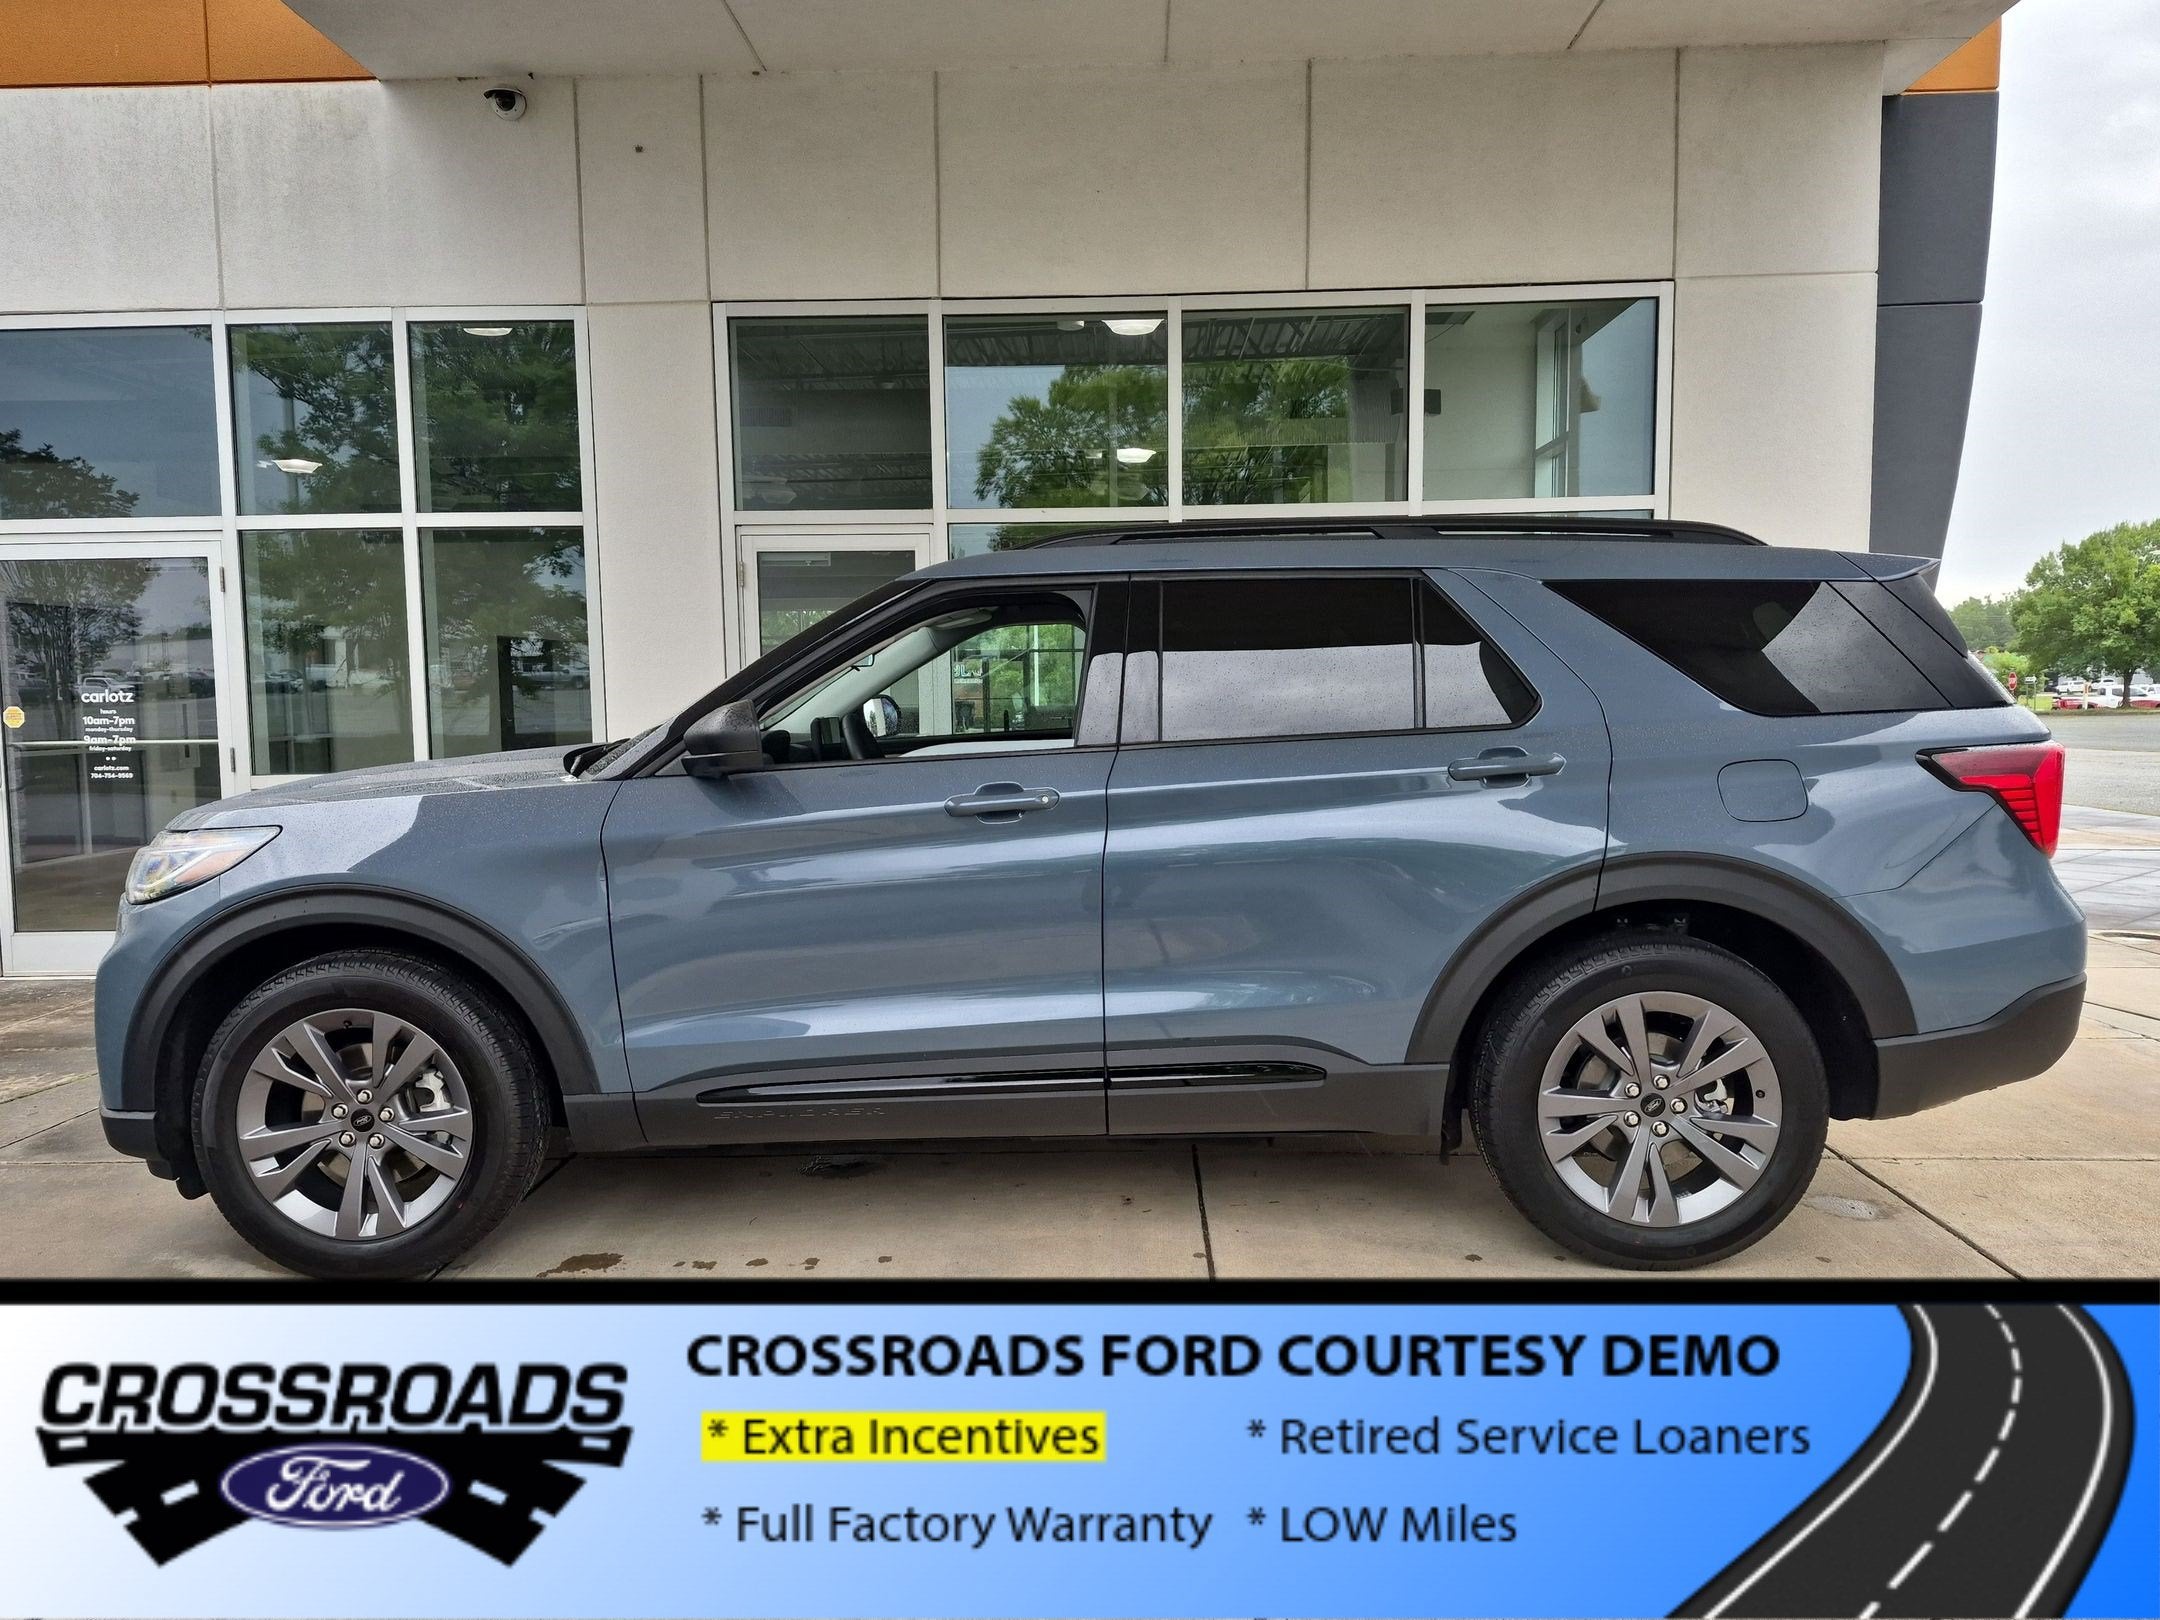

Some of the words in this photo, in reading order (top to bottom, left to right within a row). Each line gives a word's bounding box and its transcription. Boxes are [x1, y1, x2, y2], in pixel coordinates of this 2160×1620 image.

[81, 689, 134, 703] carlotz
[82, 715, 136, 727] 10am-7pm
[83, 734, 136, 746] 9am-7pm
